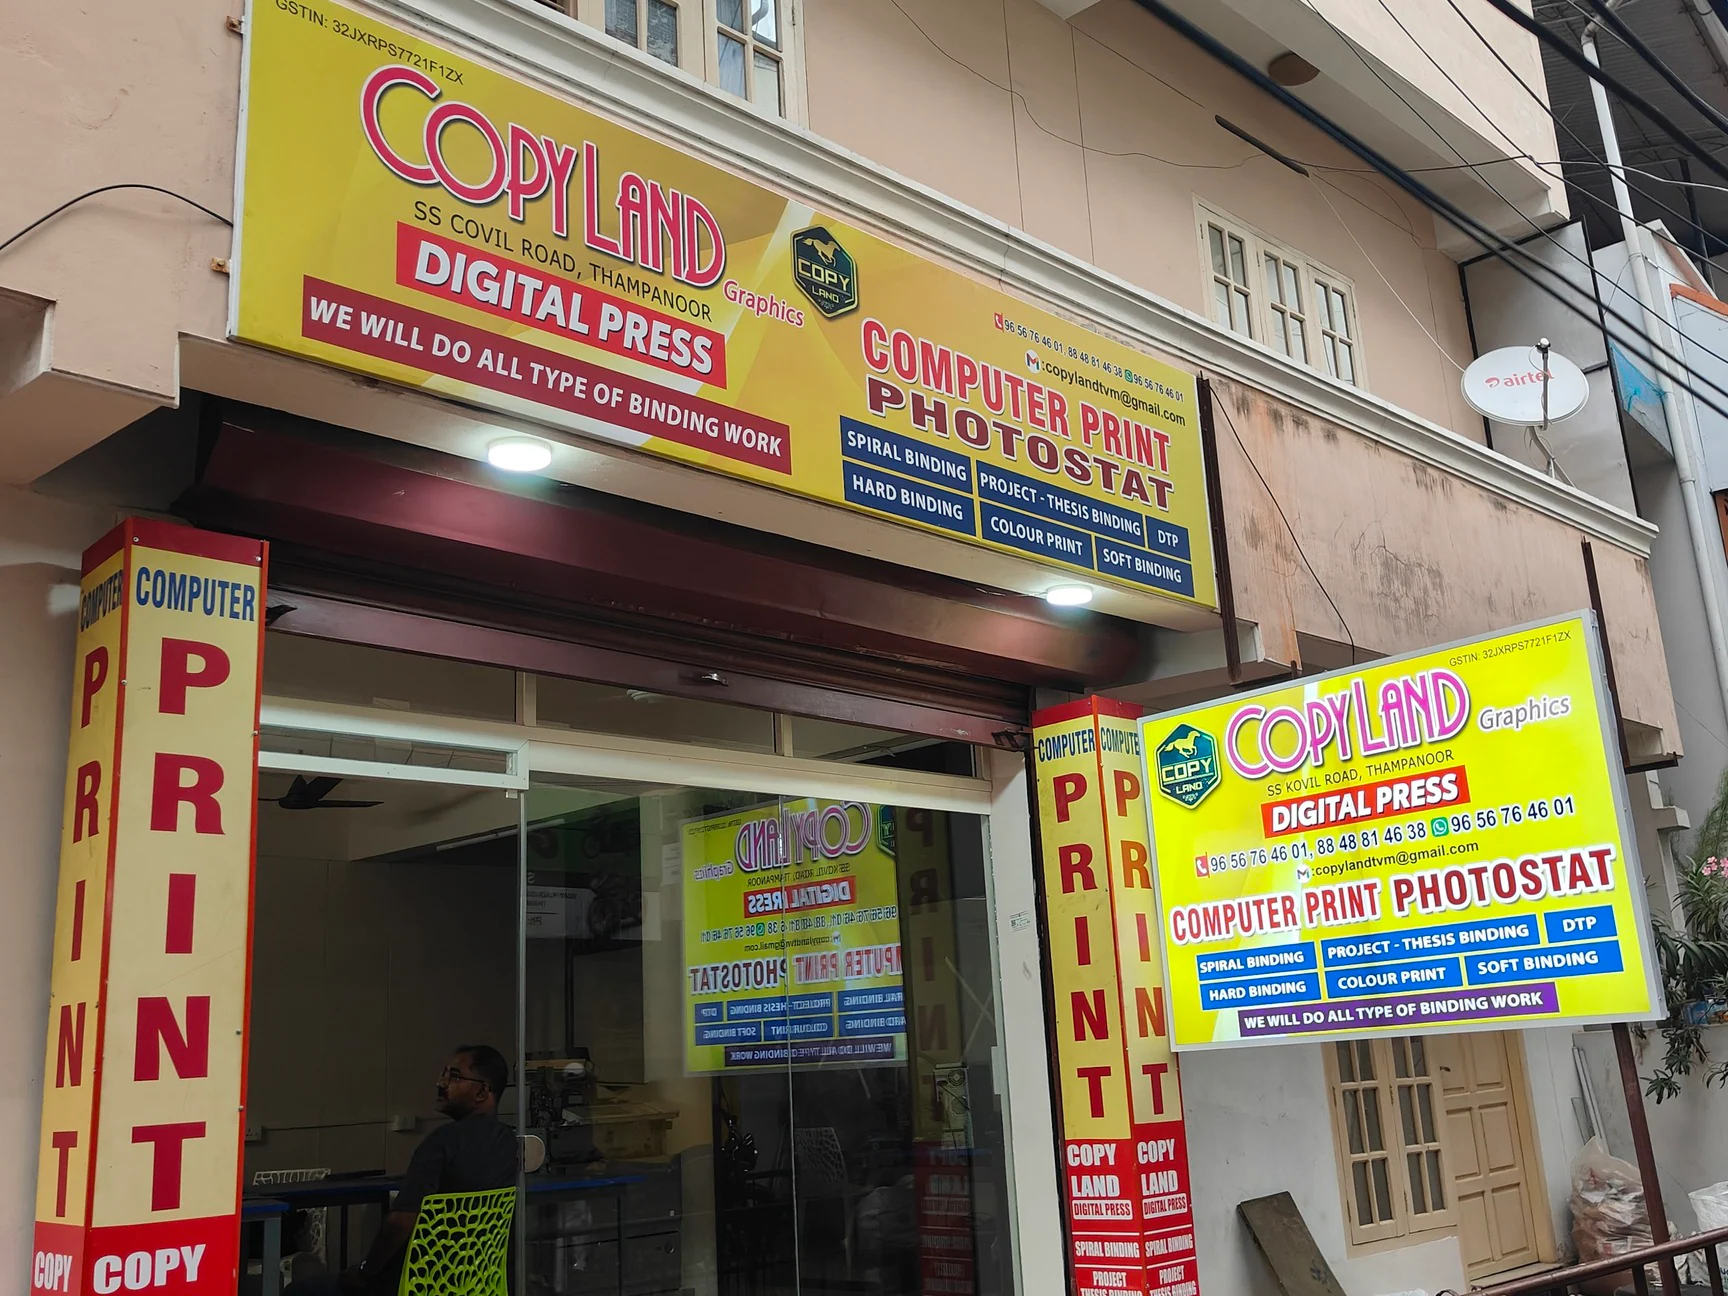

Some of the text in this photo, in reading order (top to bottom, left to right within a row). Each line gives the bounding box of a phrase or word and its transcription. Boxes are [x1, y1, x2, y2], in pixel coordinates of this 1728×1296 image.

[275, 0, 464, 85] GSTIN: 32JXRPS7721F1ZX
[414, 201, 713, 322] SS COVIL ROAD, THAMPANOOR
[798, 258, 850, 291] COPY
[414, 240, 713, 375] DIGITAL PRESS
[722, 279, 805, 329] Graphics
[811, 285, 840, 303] LAND
[310, 296, 783, 457] WE WILL DO ALL TYPE OF BINDING WORK
[1004, 319, 1015, 333] 96
[1017, 324, 1028, 338] 56
[1030, 330, 1040, 344] 76
[1041, 335, 1052, 349] 46
[1067, 346, 1078, 360] 88
[1079, 351, 1090, 365] 48
[1091, 356, 1100, 369] 81
[1102, 361, 1113, 374] 46
[1113, 365, 1123, 378] 38
[1133, 373, 1143, 386] 96
[1144, 377, 1154, 391] 56
[1155, 382, 1164, 395] 76
[1165, 386, 1175, 399] 46
[1175, 390, 1184, 403] 01
[1503, 368, 1555, 387] airtel
[862, 318, 1172, 476] COMPUTER PRINT
[847, 430, 967, 482] SPIRAL BINDING
[865, 375, 1174, 512] PHOTOSTAT
[852, 474, 964, 521] HARD BINDING
[980, 471, 1038, 502] PROJECT
[1046, 493, 1090, 520] THESIS
[1091, 509, 1142, 537] BINDING
[990, 516, 1084, 557] COLOUR PRINT
[1157, 529, 1180, 548] DTP
[1103, 547, 1182, 584] SOFT BINDING
[80, 569, 124, 633] COMPUTER
[135, 566, 256, 622] COMPUTER
[1449, 630, 1572, 667] GSTIN: 32JXRPS7721F1ZX
[1478, 694, 1571, 733] Graphics
[1038, 728, 1095, 763] COMPUTER
[1100, 727, 1140, 756] COMPUTE
[1161, 757, 1212, 782] COPY
[1175, 781, 1203, 794] LAND
[1267, 749, 1454, 797] SS KOVIL ROAD, THAMPANOOR
[1271, 773, 1459, 833] DIGITAL PRESS
[1210, 796, 1574, 872] 96 56 76 46 01, 88 48 81 46 38 96 56 76 46 01
[1171, 846, 1615, 943] COMPUTER PRINT PHOTOSTAT
[52, 645, 109, 1217] PRINT
[131, 637, 231, 1212] PRINT
[1113, 769, 1168, 1116] PRINT
[1327, 940, 1390, 959] PROJECT
[1402, 933, 1456, 951] THESIS
[1459, 924, 1529, 944] BINDING
[1562, 916, 1597, 933] DTP
[1053, 772, 1112, 1118] PRINT
[1199, 951, 1304, 974] SPIRAL BINDING
[1477, 950, 1599, 975] SOFT BINDING
[1209, 980, 1306, 1001] HARD BINDING
[1337, 967, 1446, 990] COLOUR PRINT
[1244, 991, 1544, 1029] WE WILL DO ALL TYPE OF BINDING WORK
[1067, 1143, 1117, 1166] COPY
[1137, 1138, 1175, 1164] COPY
[1071, 1175, 1120, 1197] LAND
[1140, 1169, 1178, 1196] LAND
[1074, 1203, 1131, 1216] DIGITAL PRESS
[1143, 1196, 1186, 1215] DIGITAL PRESS
[1075, 1241, 1140, 1258] SPIRAL BINDING
[1145, 1234, 1193, 1258] SPIRAL BINDING
[34, 1250, 73, 1293] COPY
[93, 1244, 207, 1295] COPY
[1092, 1270, 1127, 1287] PROJECT
